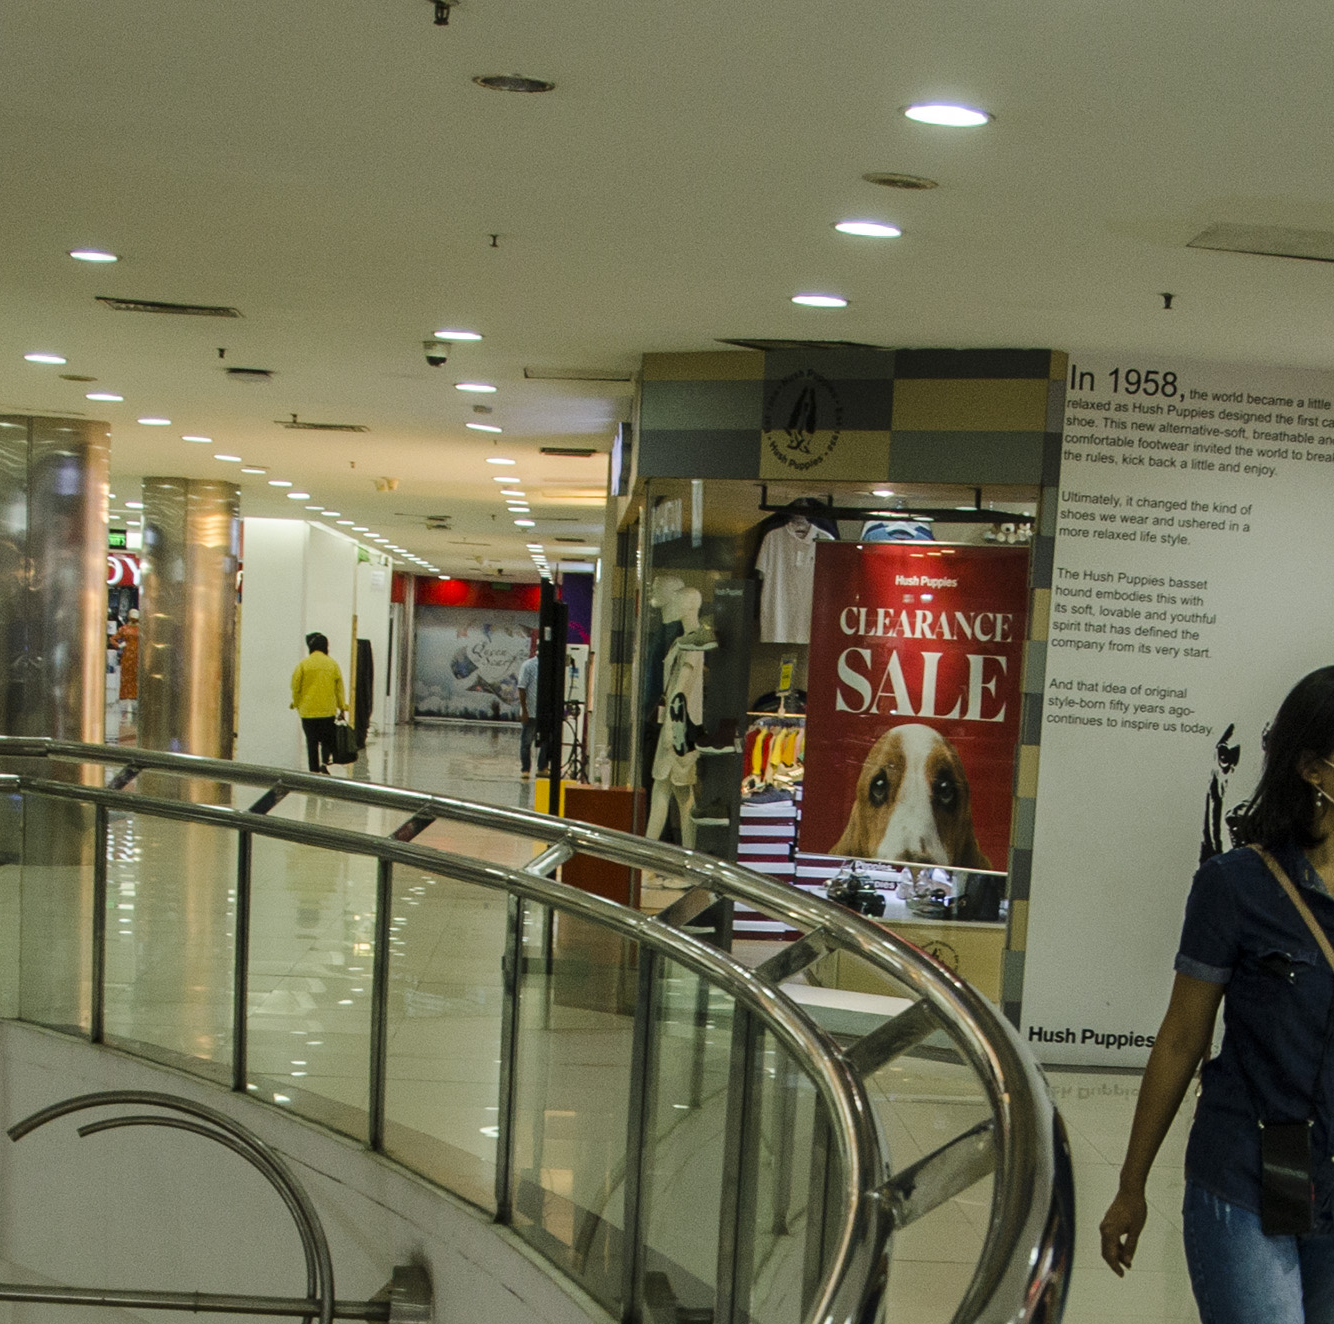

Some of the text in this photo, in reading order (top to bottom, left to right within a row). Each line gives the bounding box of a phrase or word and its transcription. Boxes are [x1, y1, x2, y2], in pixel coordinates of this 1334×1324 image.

[1070, 364, 1095, 393] In
[1108, 367, 1186, 402] 1958,
[1188, 388, 1209, 401] the
[1211, 391, 1244, 404] world
[1245, 393, 1294, 407] became
[1296, 398, 1305, 409] a
[1307, 397, 1332, 410] little
[1067, 398, 1112, 412] relaxed
[1113, 402, 1129, 413] as
[1131, 402, 1164, 415] Hush
[1166, 404, 1216, 420] Puppies
[1217, 409, 1273, 424] designed
[1274, 413, 1294, 425] the
[1296, 414, 1319, 427] first
[1103, 416, 1128, 430] This
[1130, 421, 1156, 432] new
[1252, 429, 1315, 444] breathable
[1064, 434, 1135, 448] comfortable
[1137, 437, 1189, 452] footwear
[1192, 442, 1232, 455] invited
[1234, 444, 1254, 457] the
[1256, 448, 1289, 459] world
[1291, 449, 1303, 461] to
[1063, 449, 1083, 462] the
[1121, 453, 1145, 466] kick
[1147, 455, 1177, 468] back
[1179, 459, 1188, 470] a
[1190, 458, 1215, 471] little
[1218, 462, 1241, 473] and
[1125, 495, 1134, 507] it
[1135, 497, 1188, 512] changed
[1190, 500, 1210, 513] the
[1212, 502, 1238, 515] kind
[1239, 503, 1253, 516] of
[1060, 508, 1251, 533] shoes we wear and ushered in a
[1058, 527, 1090, 538] more
[1092, 529, 1137, 541] relaxed
[1139, 530, 1158, 543] life
[895, 575, 958, 589] Hush Puppies
[1057, 566, 1208, 590] The Hush Puppies basset
[1055, 585, 1204, 607] hound embodies this with
[840, 606, 1013, 643] CLEARANCE
[1053, 601, 1068, 614] its
[1098, 605, 1142, 619] lovable
[1144, 610, 1168, 621] and
[1169, 612, 1217, 625] youthful
[1051, 620, 1200, 641] spirit that has defined the
[1050, 637, 1106, 653] company
[1107, 639, 1136, 653] from
[1137, 642, 1152, 654] its
[1154, 646, 1180, 659] very
[835, 646, 1007, 723] SALE
[1048, 677, 1188, 700] And that idea of original
[1047, 695, 1195, 719] style-born fifty years ago-
[1046, 713, 1103, 728] continues
[1106, 716, 1118, 728] to
[1120, 718, 1160, 731] inspire
[1162, 722, 1177, 733] us
[1028, 1026, 1156, 1050] Hush Puppies
